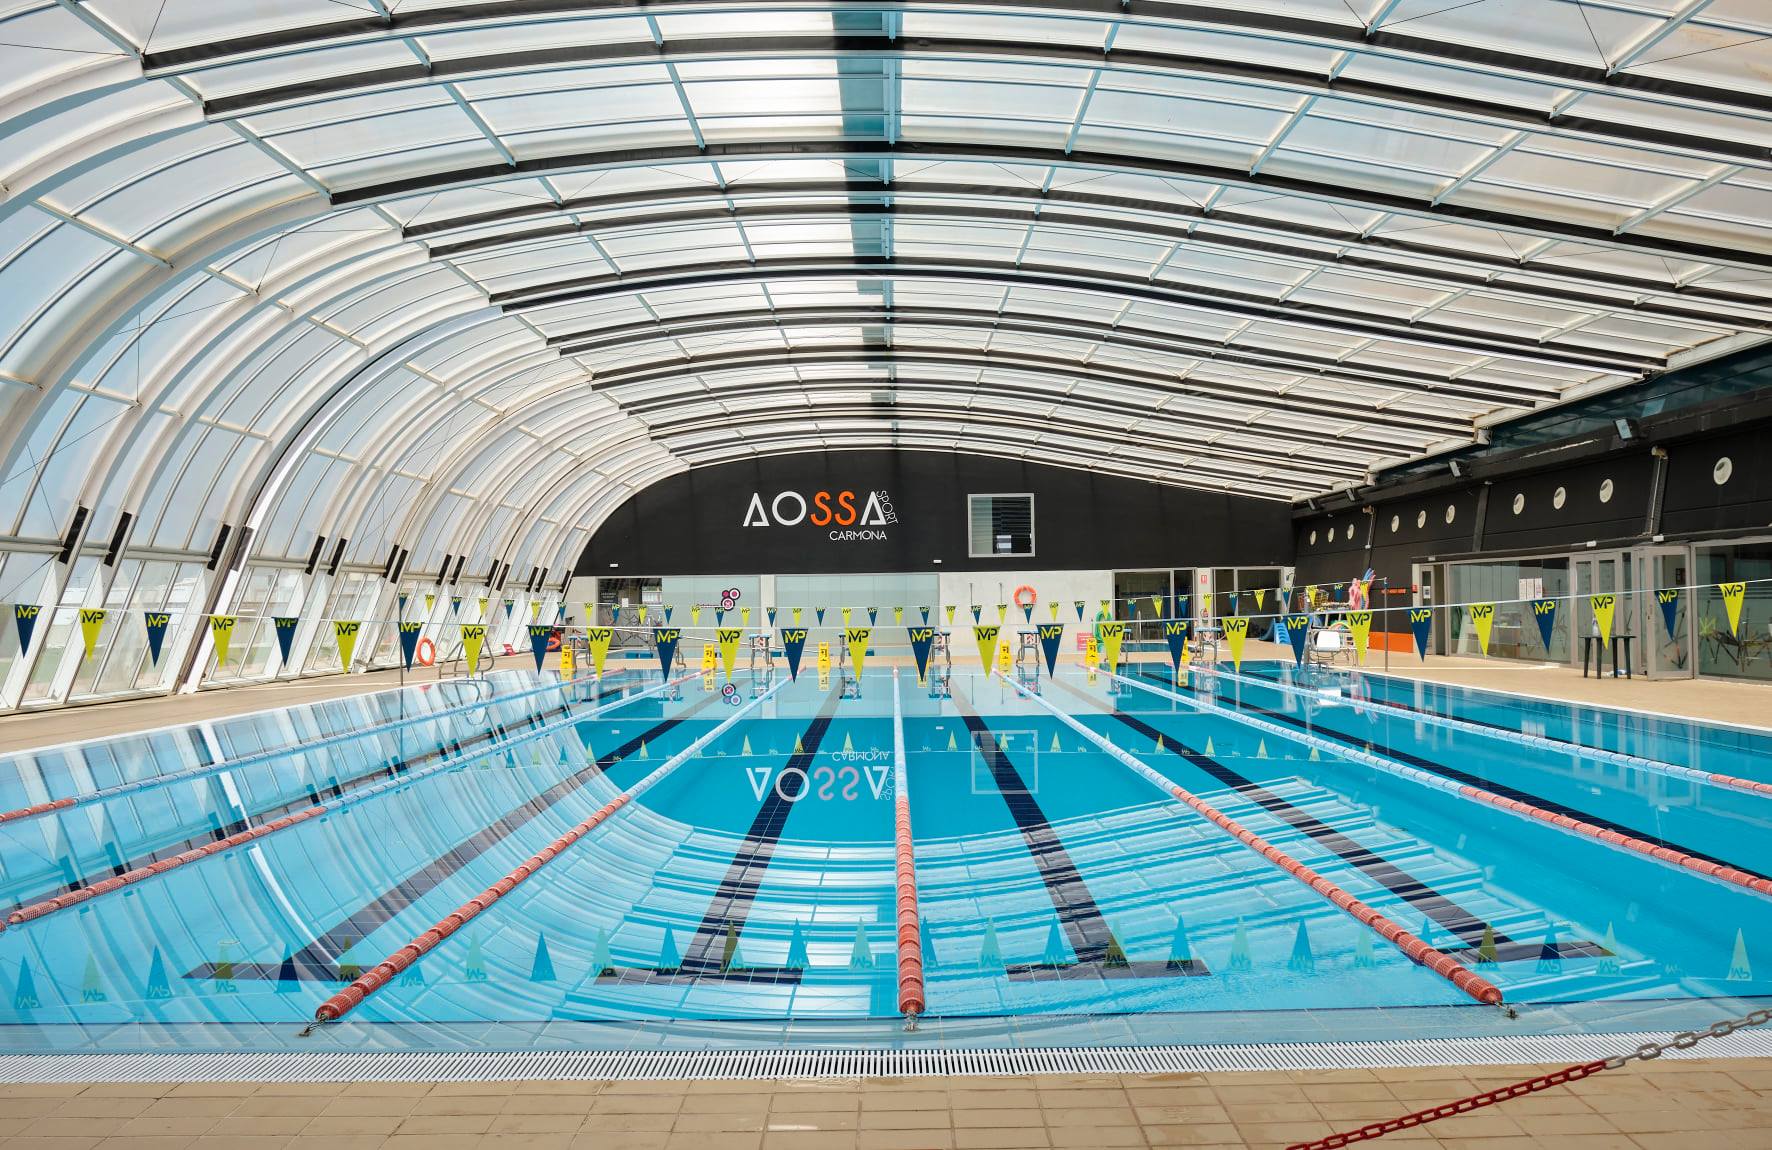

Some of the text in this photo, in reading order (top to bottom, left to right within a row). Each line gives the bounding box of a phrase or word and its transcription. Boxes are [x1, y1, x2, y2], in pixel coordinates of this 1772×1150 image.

[743, 491, 887, 527] AOSSA
[876, 490, 899, 525] SPORT
[829, 530, 887, 541] CARMONA
[1658, 590, 1678, 603] MP
[1724, 584, 1743, 597] MP
[1534, 601, 1555, 615] MP
[1594, 597, 1614, 609] MP
[17, 605, 39, 619] MP
[81, 611, 105, 624] MP
[1411, 609, 1432, 623] MP
[1473, 605, 1493, 619] MP
[147, 614, 169, 628] MP
[213, 617, 234, 630] MP
[277, 618, 297, 628] MP
[1287, 616, 1308, 630] MP
[1350, 613, 1370, 625] MP
[337, 623, 359, 636] MP
[400, 622, 422, 633] MP
[531, 626, 551, 636] MP
[1041, 625, 1062, 640] MP
[1102, 625, 1123, 638] MP
[1166, 622, 1187, 635] MP
[1226, 620, 1247, 633] MP
[463, 627, 484, 640] MP
[590, 629, 611, 643] MP
[657, 630, 679, 643] MP
[719, 630, 740, 643] MP
[784, 630, 806, 644] MP
[849, 630, 869, 643] MP
[911, 629, 933, 642] MP
[977, 628, 998, 641] MP
